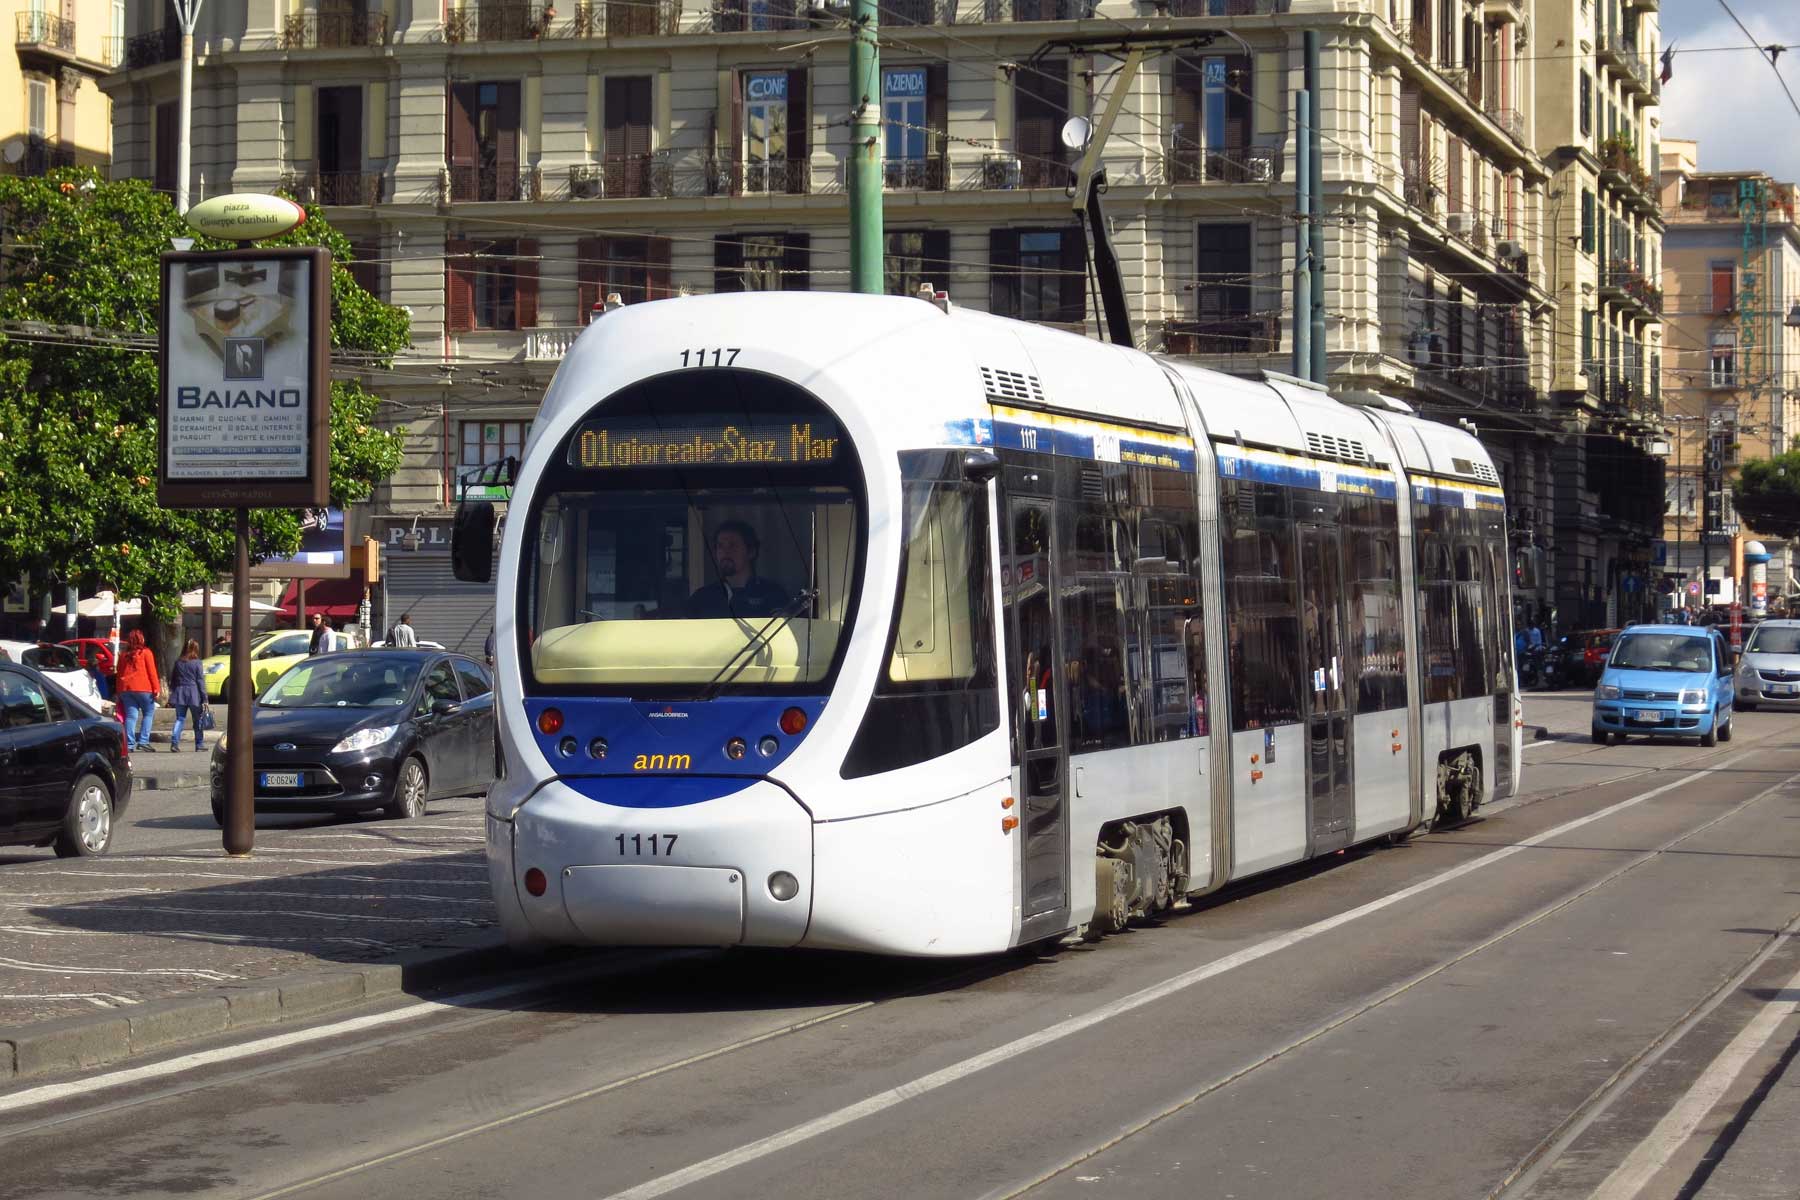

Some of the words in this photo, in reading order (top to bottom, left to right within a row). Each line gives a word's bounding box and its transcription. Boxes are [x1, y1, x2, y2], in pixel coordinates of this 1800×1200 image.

[750, 77, 785, 97] CONF
[886, 73, 924, 92] AZIENDA
[223, 203, 250, 214] piazza
[200, 216, 235, 228] Giuseppe
[237, 214, 279, 225] Garibaldi
[680, 348, 741, 367] 1117
[177, 386, 300, 409] BAIANO
[180, 424, 222, 432] CERAMICHE
[236, 424, 259, 432] SCALE
[180, 434, 212, 442] PARQUET
[581, 430, 612, 467] 01
[791, 423, 839, 462] Mar
[1020, 428, 1037, 450] 1117
[1223, 458, 1236, 476] 1117
[389, 527, 454, 545] PEL
[633, 753, 691, 771] anm
[615, 833, 678, 856] 1117
